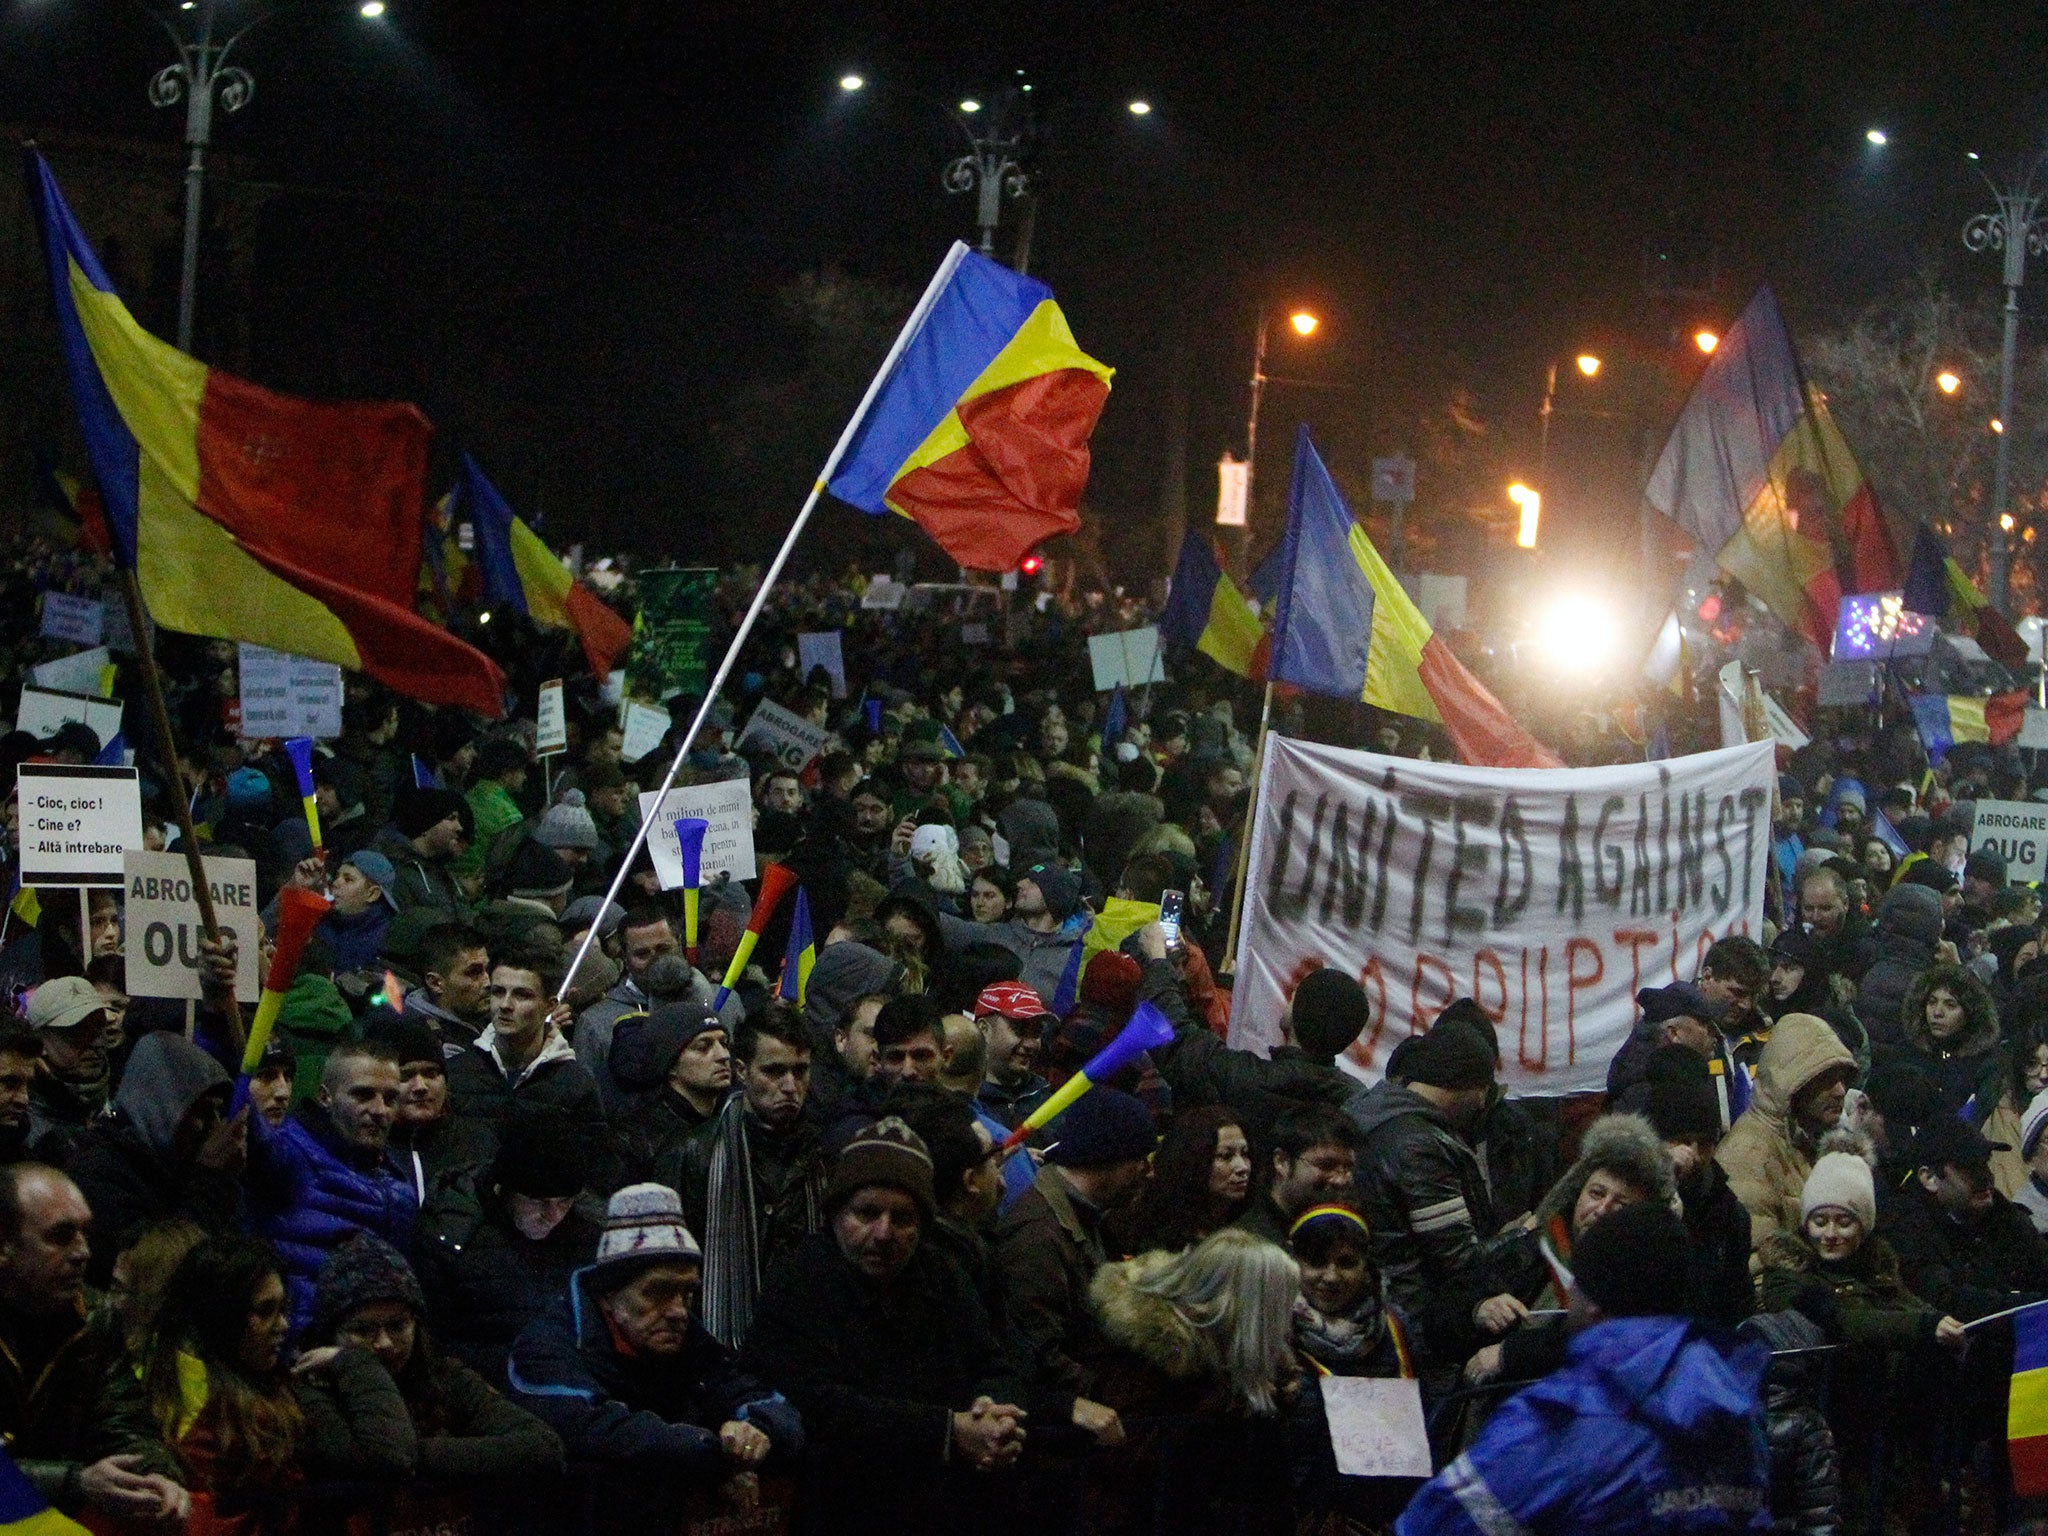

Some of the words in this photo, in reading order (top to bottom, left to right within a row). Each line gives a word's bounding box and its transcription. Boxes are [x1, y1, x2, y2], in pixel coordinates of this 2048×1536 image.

[37, 796, 67, 811] Cioc,
[70, 797, 96, 809] cioc
[666, 805, 704, 821] milion
[706, 803, 717, 816] de
[38, 818, 64, 831] Cine
[67, 819, 81, 831] e?
[1978, 814, 2046, 830] ABROGARE
[38, 841, 62, 853] Altă
[65, 841, 123, 854] întrebare
[711, 838, 737, 855] pentru
[1268, 767, 1533, 948] UNITED
[1555, 766, 1767, 924] AGAINST
[131, 876, 251, 907] ABROARE
[1279, 909, 1749, 1073] ORRUPTI
